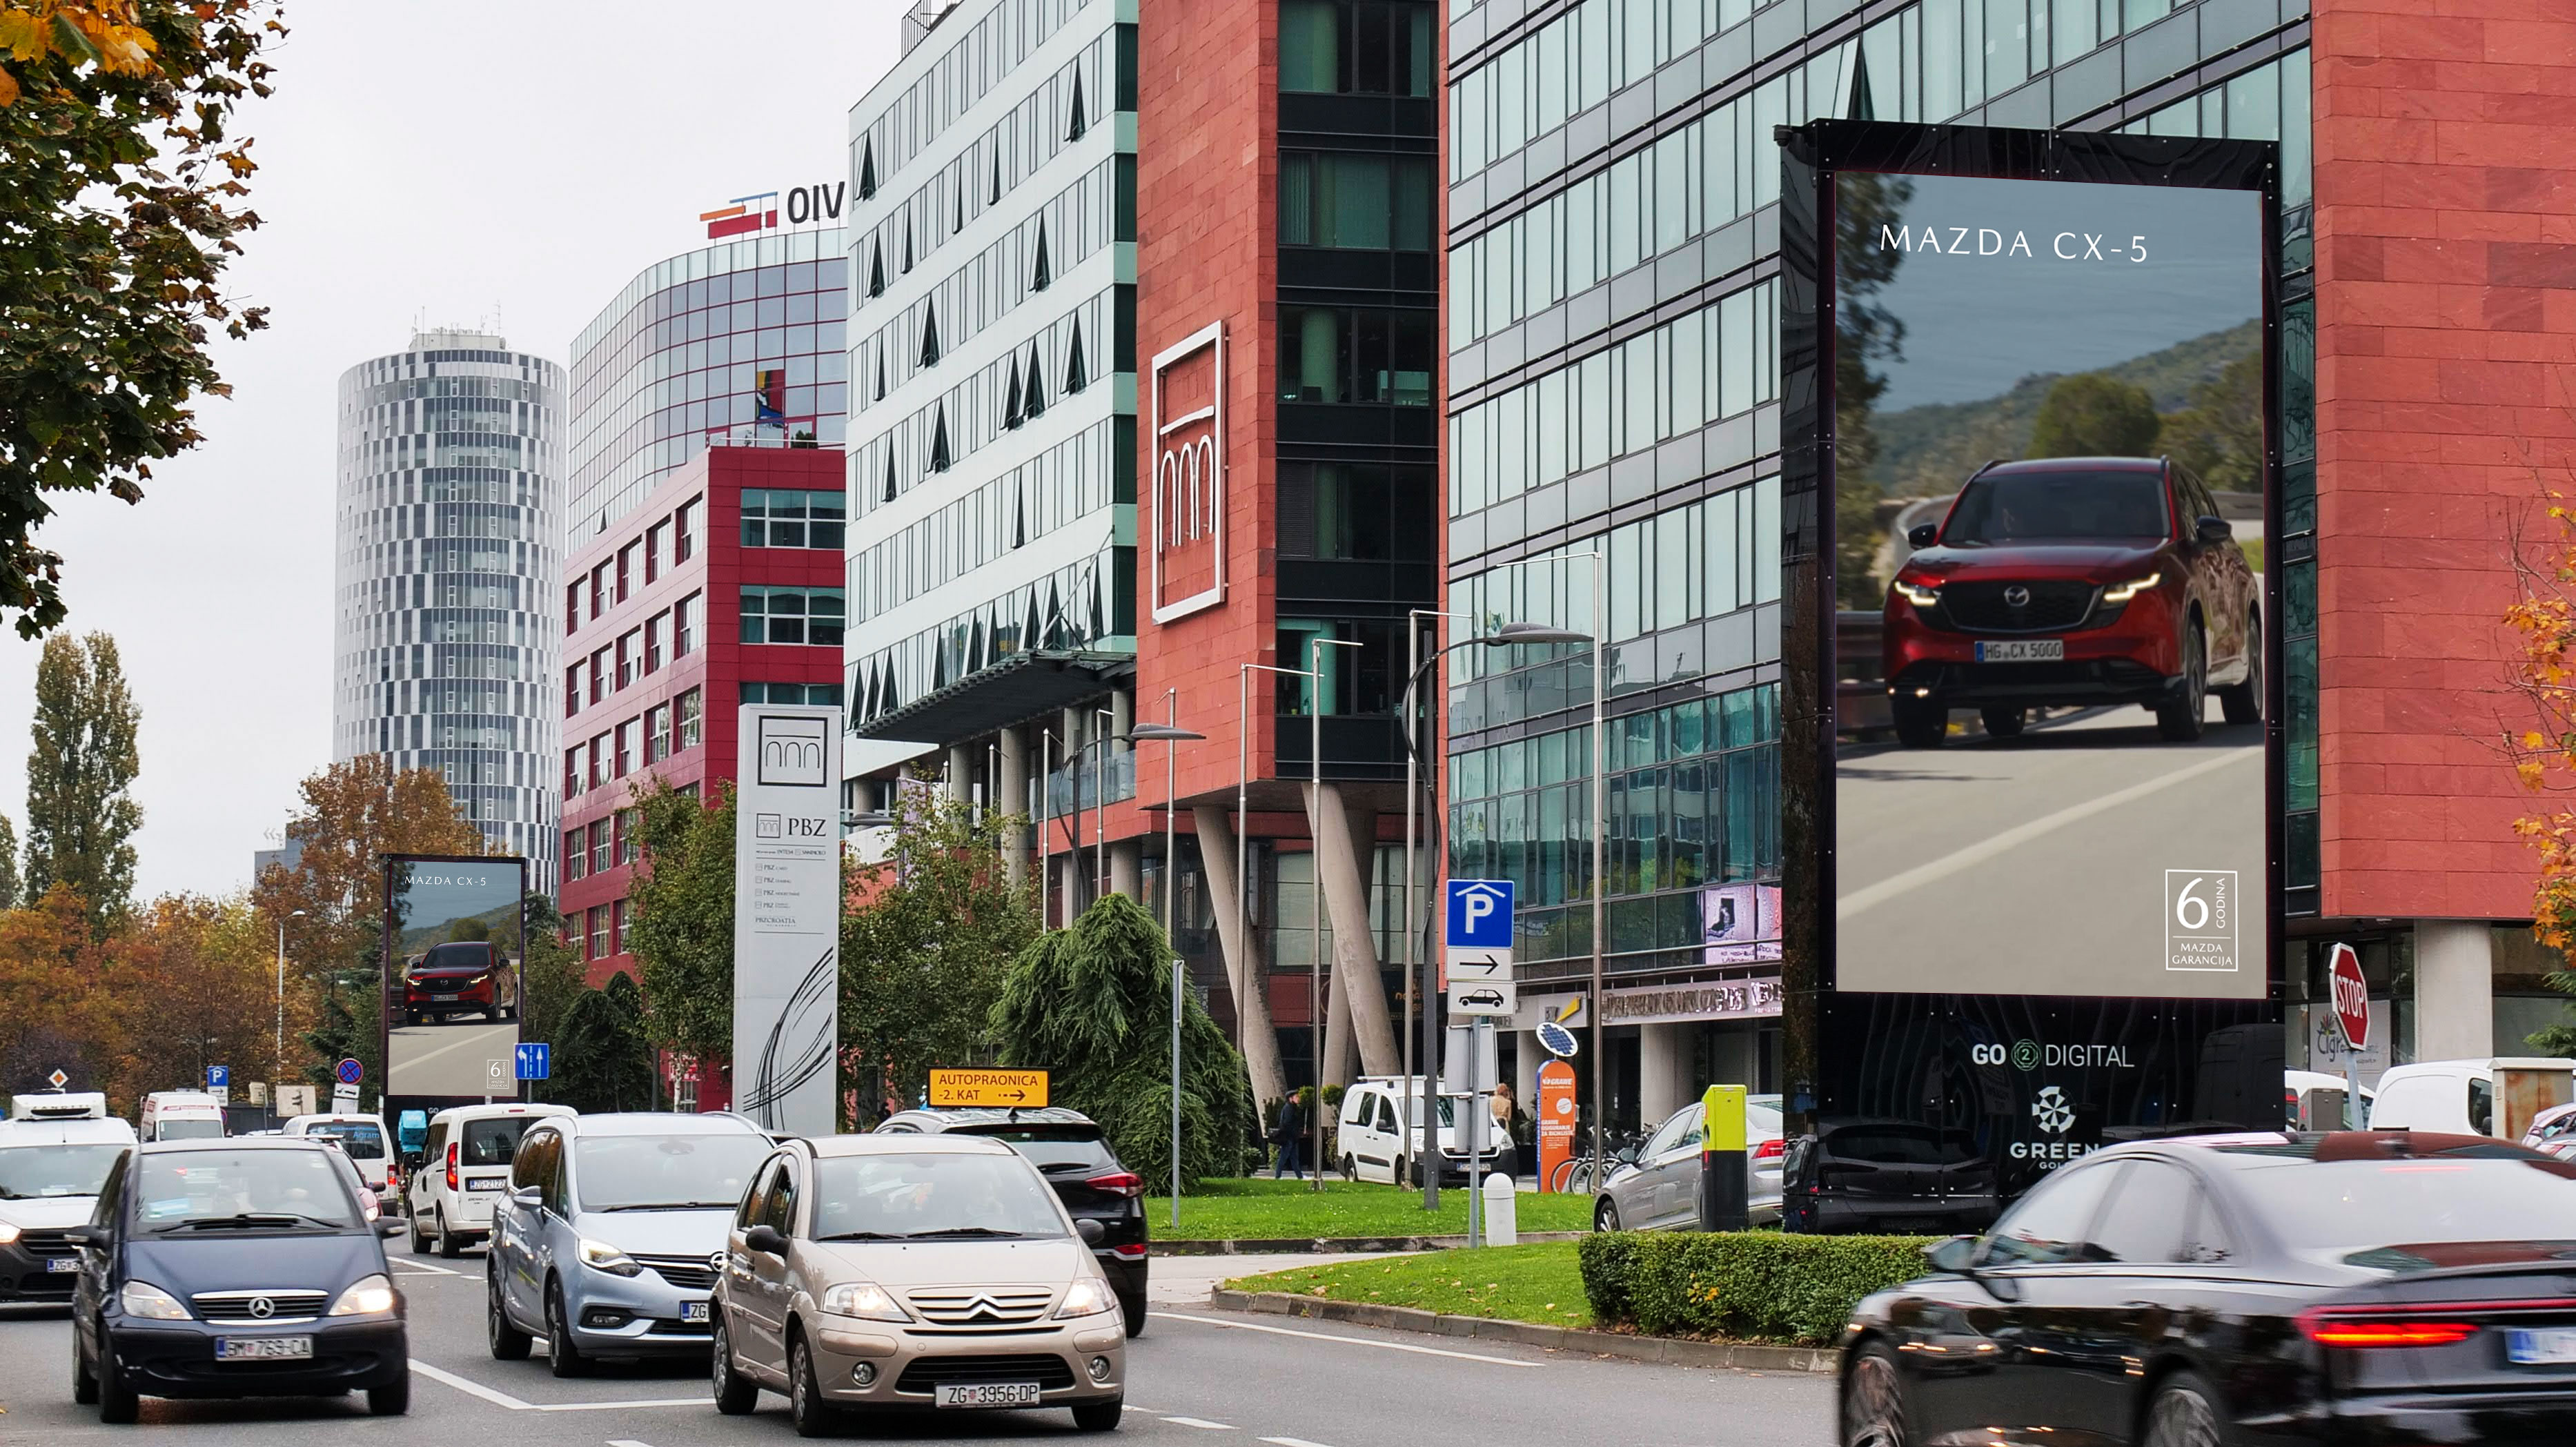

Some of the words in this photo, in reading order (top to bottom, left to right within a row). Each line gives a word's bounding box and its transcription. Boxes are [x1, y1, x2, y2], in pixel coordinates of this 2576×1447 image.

[787, 181, 845, 224] OIV
[1880, 224, 2033, 257] MAZDA
[2054, 232, 2147, 263] CX-5
[1985, 644, 2001, 658] HG
[2010, 643, 2027, 658] CX
[2029, 642, 2062, 658] 5000
[787, 818, 827, 838] PBZ
[404, 876, 451, 885] MAZDA
[457, 877, 486, 886] CX-5
[2176, 877, 2209, 929] 6
[2216, 878, 2225, 929] GODINA
[1465, 893, 1494, 934] P
[2181, 943, 2223, 953] MAZDA
[2172, 955, 2233, 966] GARANCIJA
[2336, 974, 2365, 1018] STOP
[1972, 1043, 2006, 1065] GO
[2021, 1048, 2030, 1061] 2
[2045, 1044, 2135, 1067] DIGITAL
[213, 1070, 223, 1083] P
[491, 1061, 500, 1076] 6
[938, 1074, 1038, 1086] AUTOPRAONICA
[938, 1090, 954, 1100] -2.
[957, 1090, 981, 1100] KAT
[2009, 1142, 2099, 1159] GREEN
[55, 1261, 67, 1270] ZG
[691, 1304, 707, 1319] ZG
[948, 1387, 967, 1404] ZG
